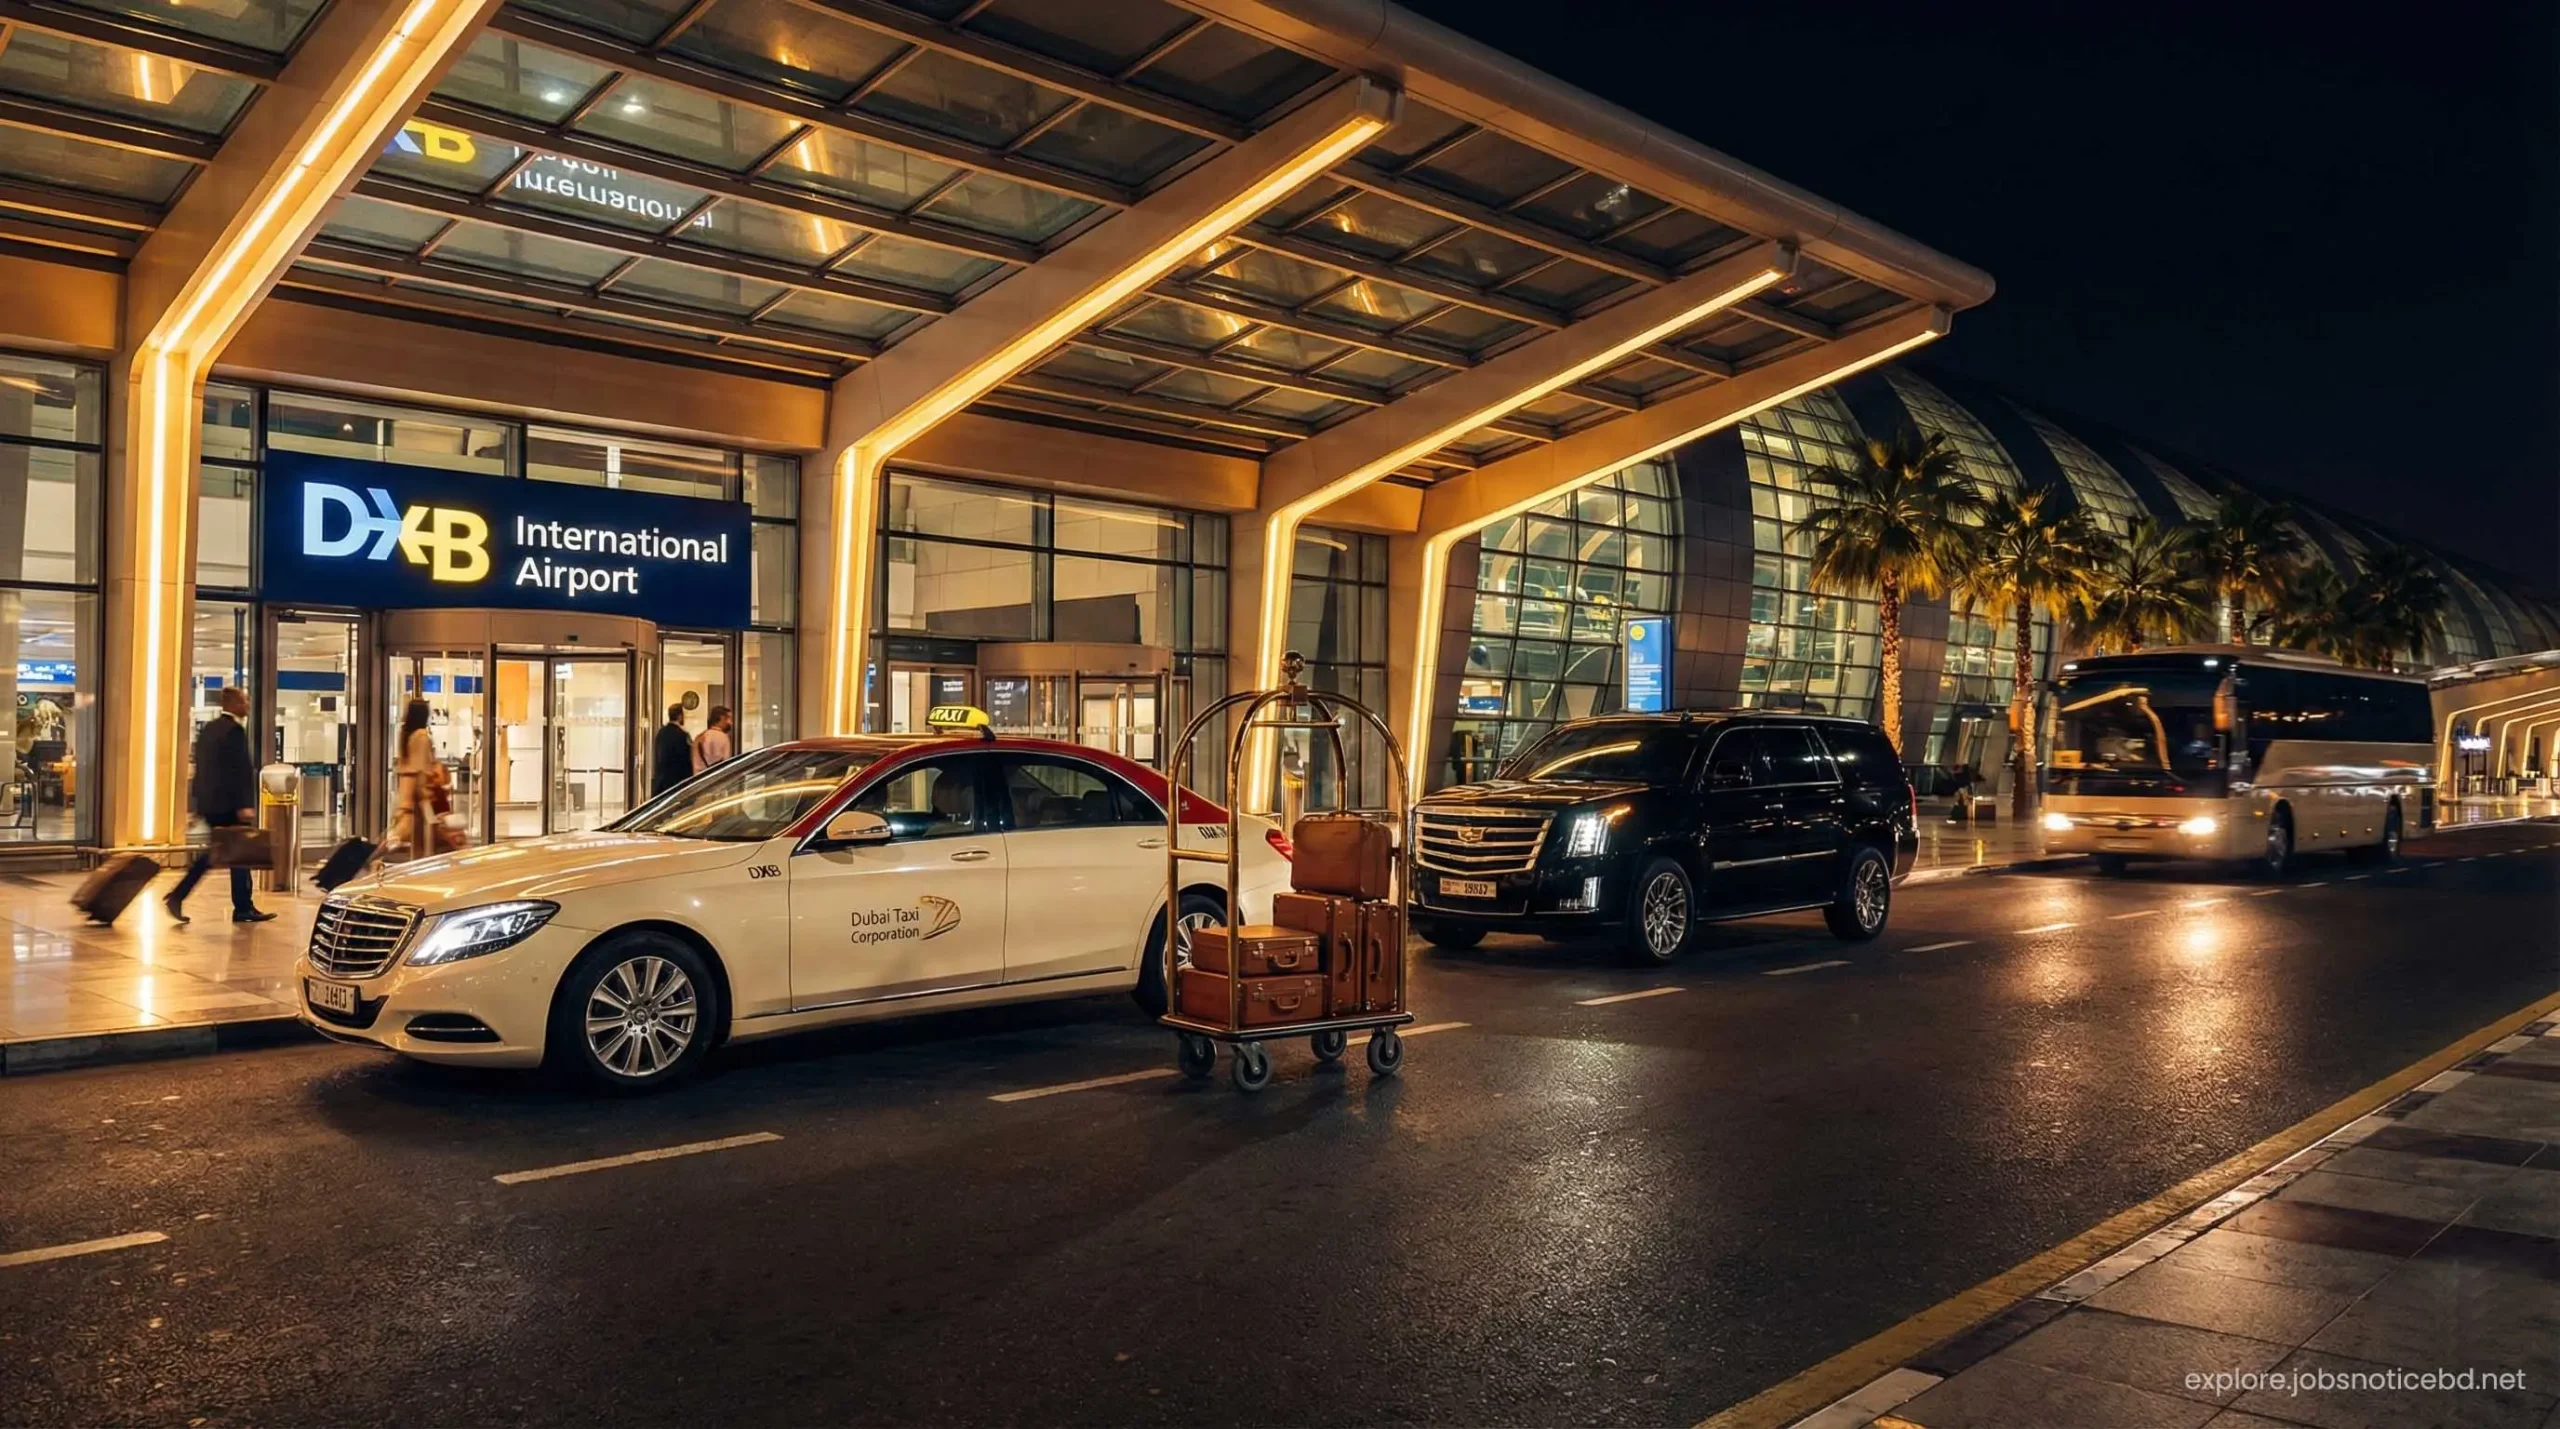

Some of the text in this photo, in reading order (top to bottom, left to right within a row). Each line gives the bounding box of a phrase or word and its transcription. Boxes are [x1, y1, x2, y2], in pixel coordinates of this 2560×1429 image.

[303, 482, 490, 583] DXB
[517, 515, 727, 563] International
[516, 557, 638, 597] Airport
[851, 906, 920, 927] Dubai Taxi
[851, 926, 920, 946] Corporation
